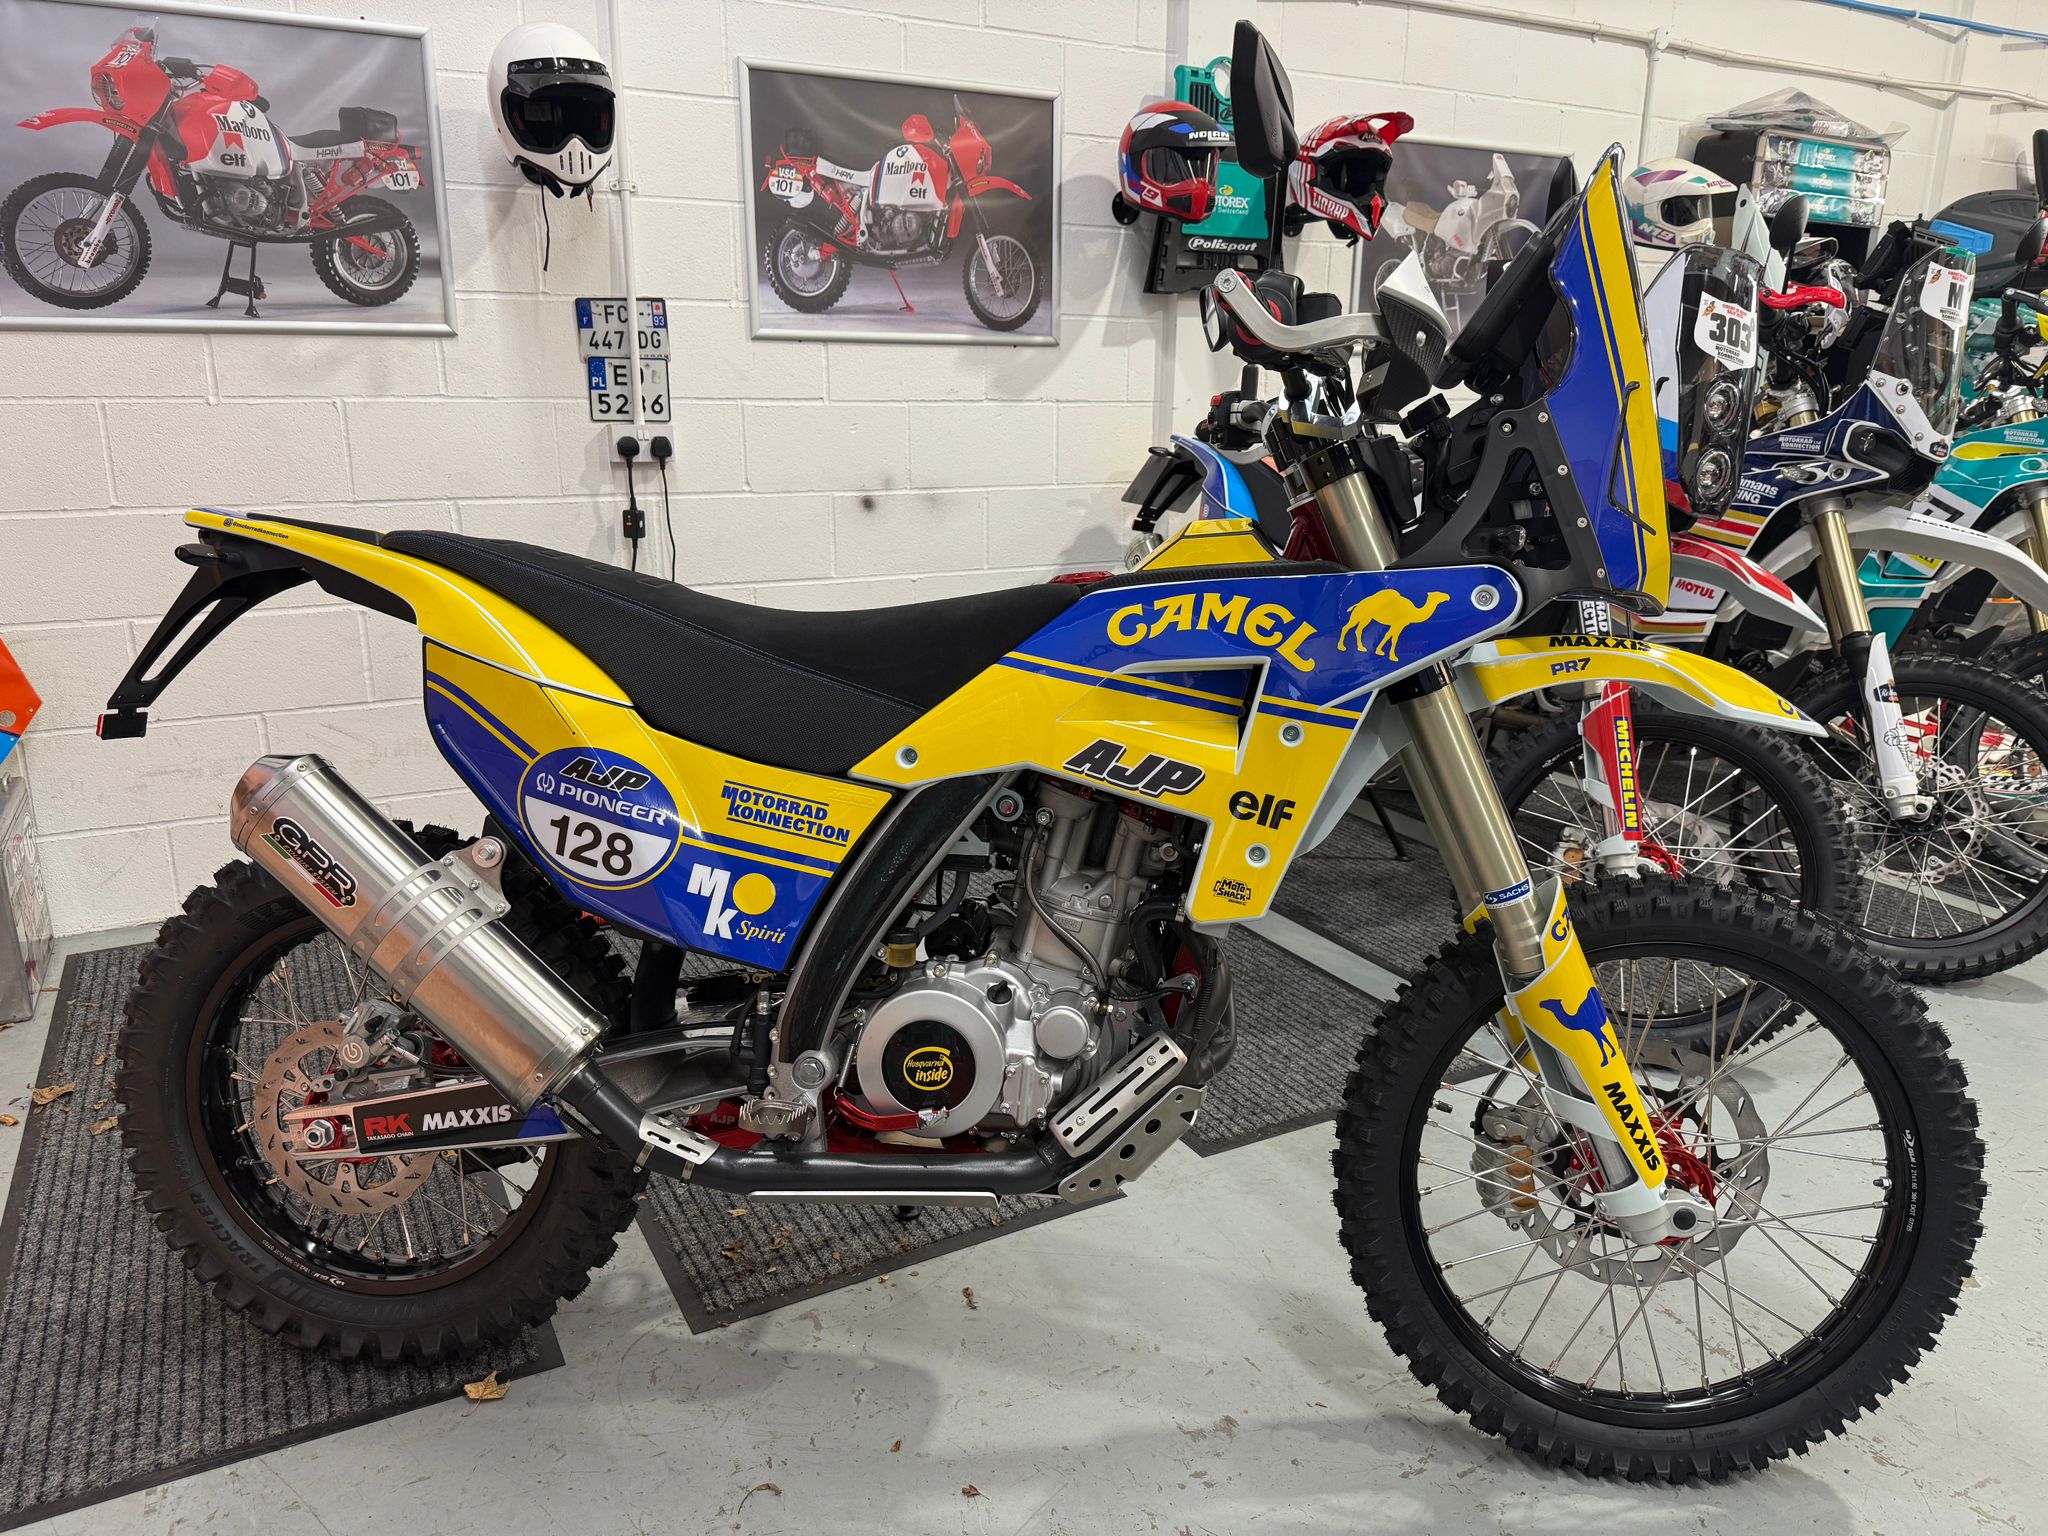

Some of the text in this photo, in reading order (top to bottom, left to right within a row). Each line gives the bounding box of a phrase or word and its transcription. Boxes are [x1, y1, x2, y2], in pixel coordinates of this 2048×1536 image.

[214, 115, 271, 142] Marlboro
[1189, 130, 1230, 141] NOLAN
[220, 153, 247, 168] elf
[316, 148, 340, 158] HPN
[835, 168, 855, 181] HPN
[885, 160, 927, 176] Marlboro
[389, 172, 411, 187] 101
[775, 179, 793, 193] 101
[909, 187, 928, 199] elf
[1189, 236, 1258, 252] Polisport
[583, 317, 588, 325] F
[653, 316, 665, 326] 93
[589, 331, 625, 350] 447
[591, 376, 606, 388] PL
[2004, 430, 2039, 438] MOTORRAD
[1675, 578, 1715, 600] MOTUL
[1106, 592, 1319, 673] CAMEL
[1549, 636, 1651, 652] MAXXIS
[1550, 657, 1592, 676] PR7
[559, 756, 651, 792] AJP
[1062, 737, 1206, 799] AJP
[1615, 719, 1639, 829] MICHELIN
[559, 782, 668, 827] PIONEER
[720, 785, 828, 821] MOTORRAD
[1228, 790, 1297, 831] elf
[550, 814, 634, 877] 128
[1216, 887, 1246, 901] SHACK
[1498, 883, 1530, 900] SACHS
[736, 919, 787, 944] Spirit
[906, 1058, 945, 1069] Husqvarna
[915, 1066, 948, 1082] inside
[363, 1104, 512, 1137] RK MAXXIS
[1602, 1081, 1661, 1171] MAXXIS
[366, 1131, 414, 1142] TAKASAGO CHAIN
[1909, 1204, 1917, 1217] DOT
[190, 1192, 267, 1274] TRACKER
